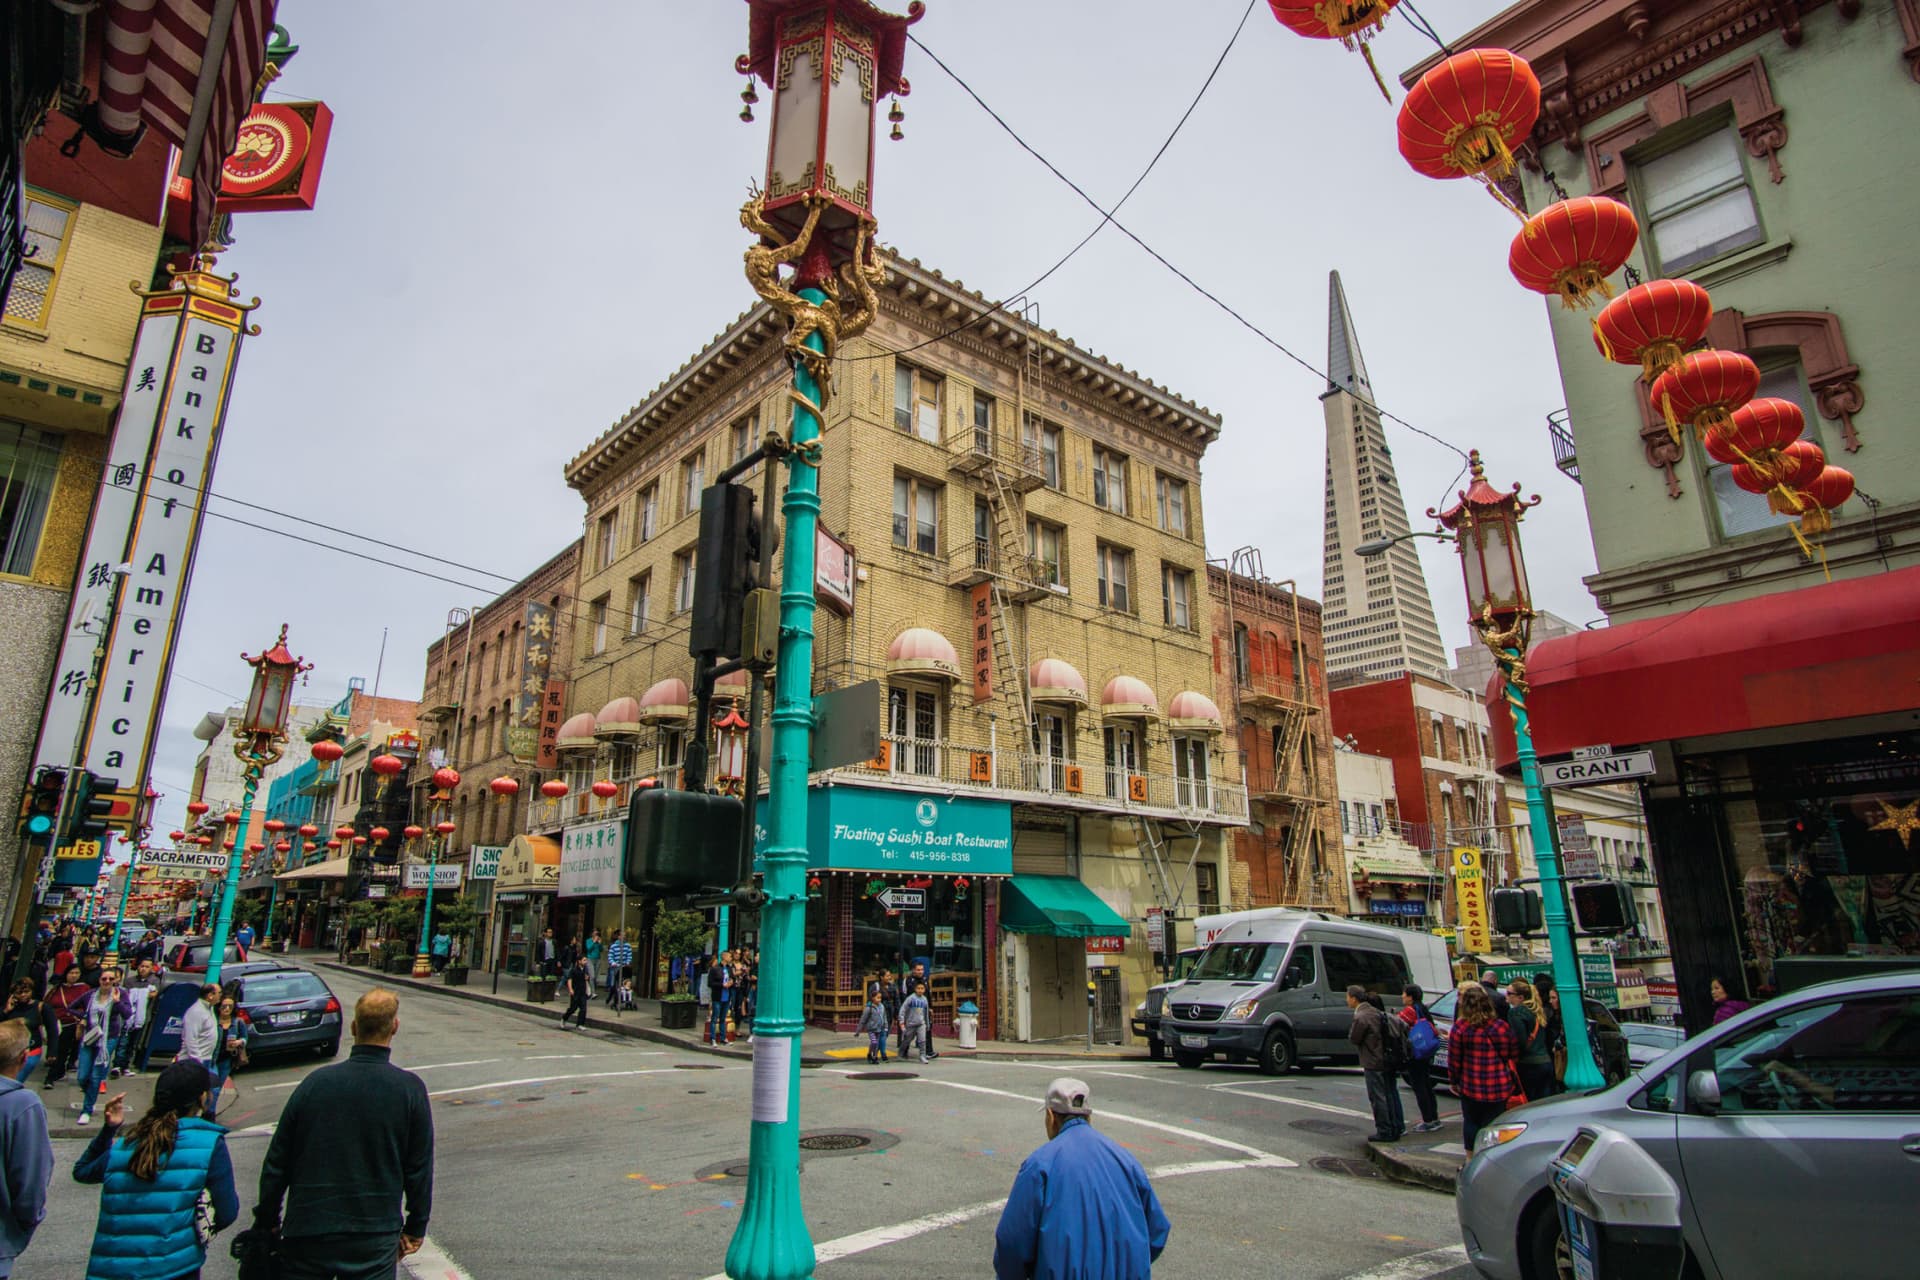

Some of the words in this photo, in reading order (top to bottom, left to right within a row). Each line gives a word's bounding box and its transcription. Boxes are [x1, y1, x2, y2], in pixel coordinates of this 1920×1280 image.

[177, 334, 216, 440] Bank
[164, 469, 185, 519] of
[59, 367, 158, 697] 美國銀行
[105, 553, 166, 769] America
[1586, 746, 1607, 757] 700
[1555, 758, 1633, 780] GRANT
[833, 824, 885, 846] Floating
[887, 828, 923, 847] Sushi
[925, 833, 952, 846] Boat
[955, 833, 1009, 849] Restaurant
[144, 851, 226, 867] SACRAMENTO
[881, 849, 898, 859] Tel:
[434, 871, 457, 879] SHOP
[1457, 868, 1480, 879] LUCKY
[891, 894, 905, 903] ONE
[906, 895, 920, 904] WAY
[1463, 881, 1483, 947] MASSAGE
